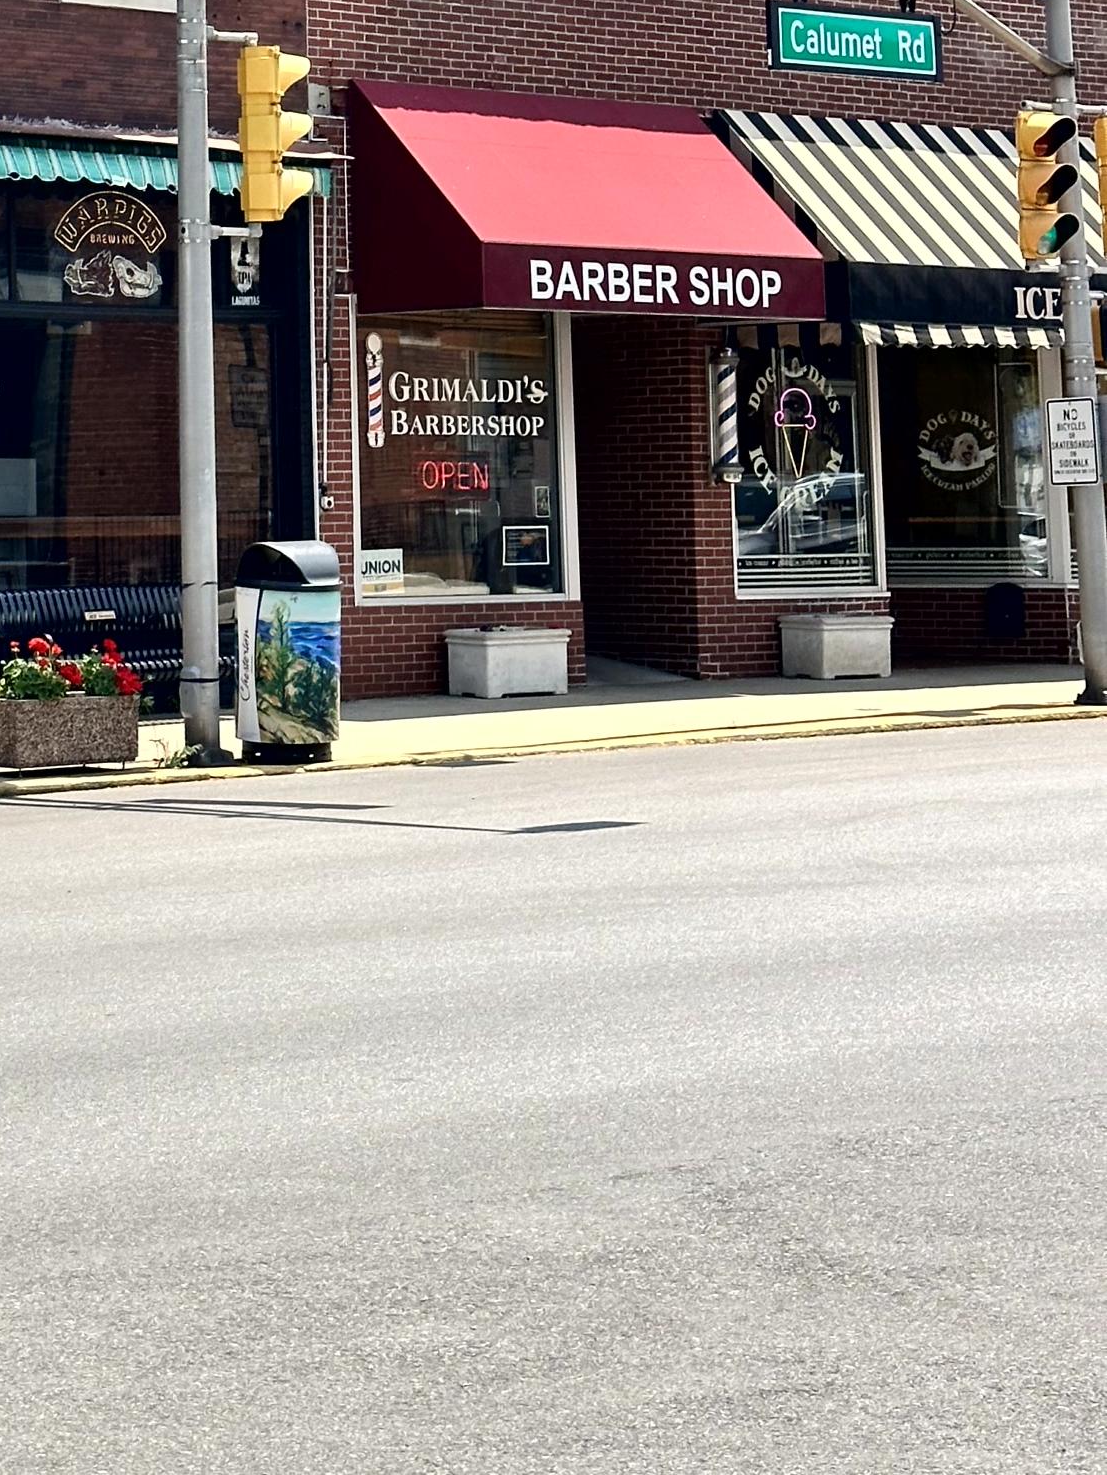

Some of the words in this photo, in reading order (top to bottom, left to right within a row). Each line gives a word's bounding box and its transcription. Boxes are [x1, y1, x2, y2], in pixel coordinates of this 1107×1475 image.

[789, 20, 883, 61] Calumet
[897, 30, 927, 64] Rd
[57, 197, 162, 247] WARPIGS
[90, 233, 135, 245] BREWING
[529, 259, 680, 305] BARBER
[689, 265, 782, 309] SHOP
[1013, 286, 1064, 322] ICE
[388, 371, 549, 404] GRIMALDI'S
[748, 366, 777, 413] DOG
[806, 364, 841, 414] DAYS
[390, 409, 545, 437] BARBERSHOP
[918, 413, 948, 443] DOG
[960, 411, 996, 441] DAYS
[1056, 421, 1087, 432] BICYCLES
[1062, 408, 1078, 421] NO
[422, 460, 490, 491] OPEN
[748, 445, 779, 496] ICE
